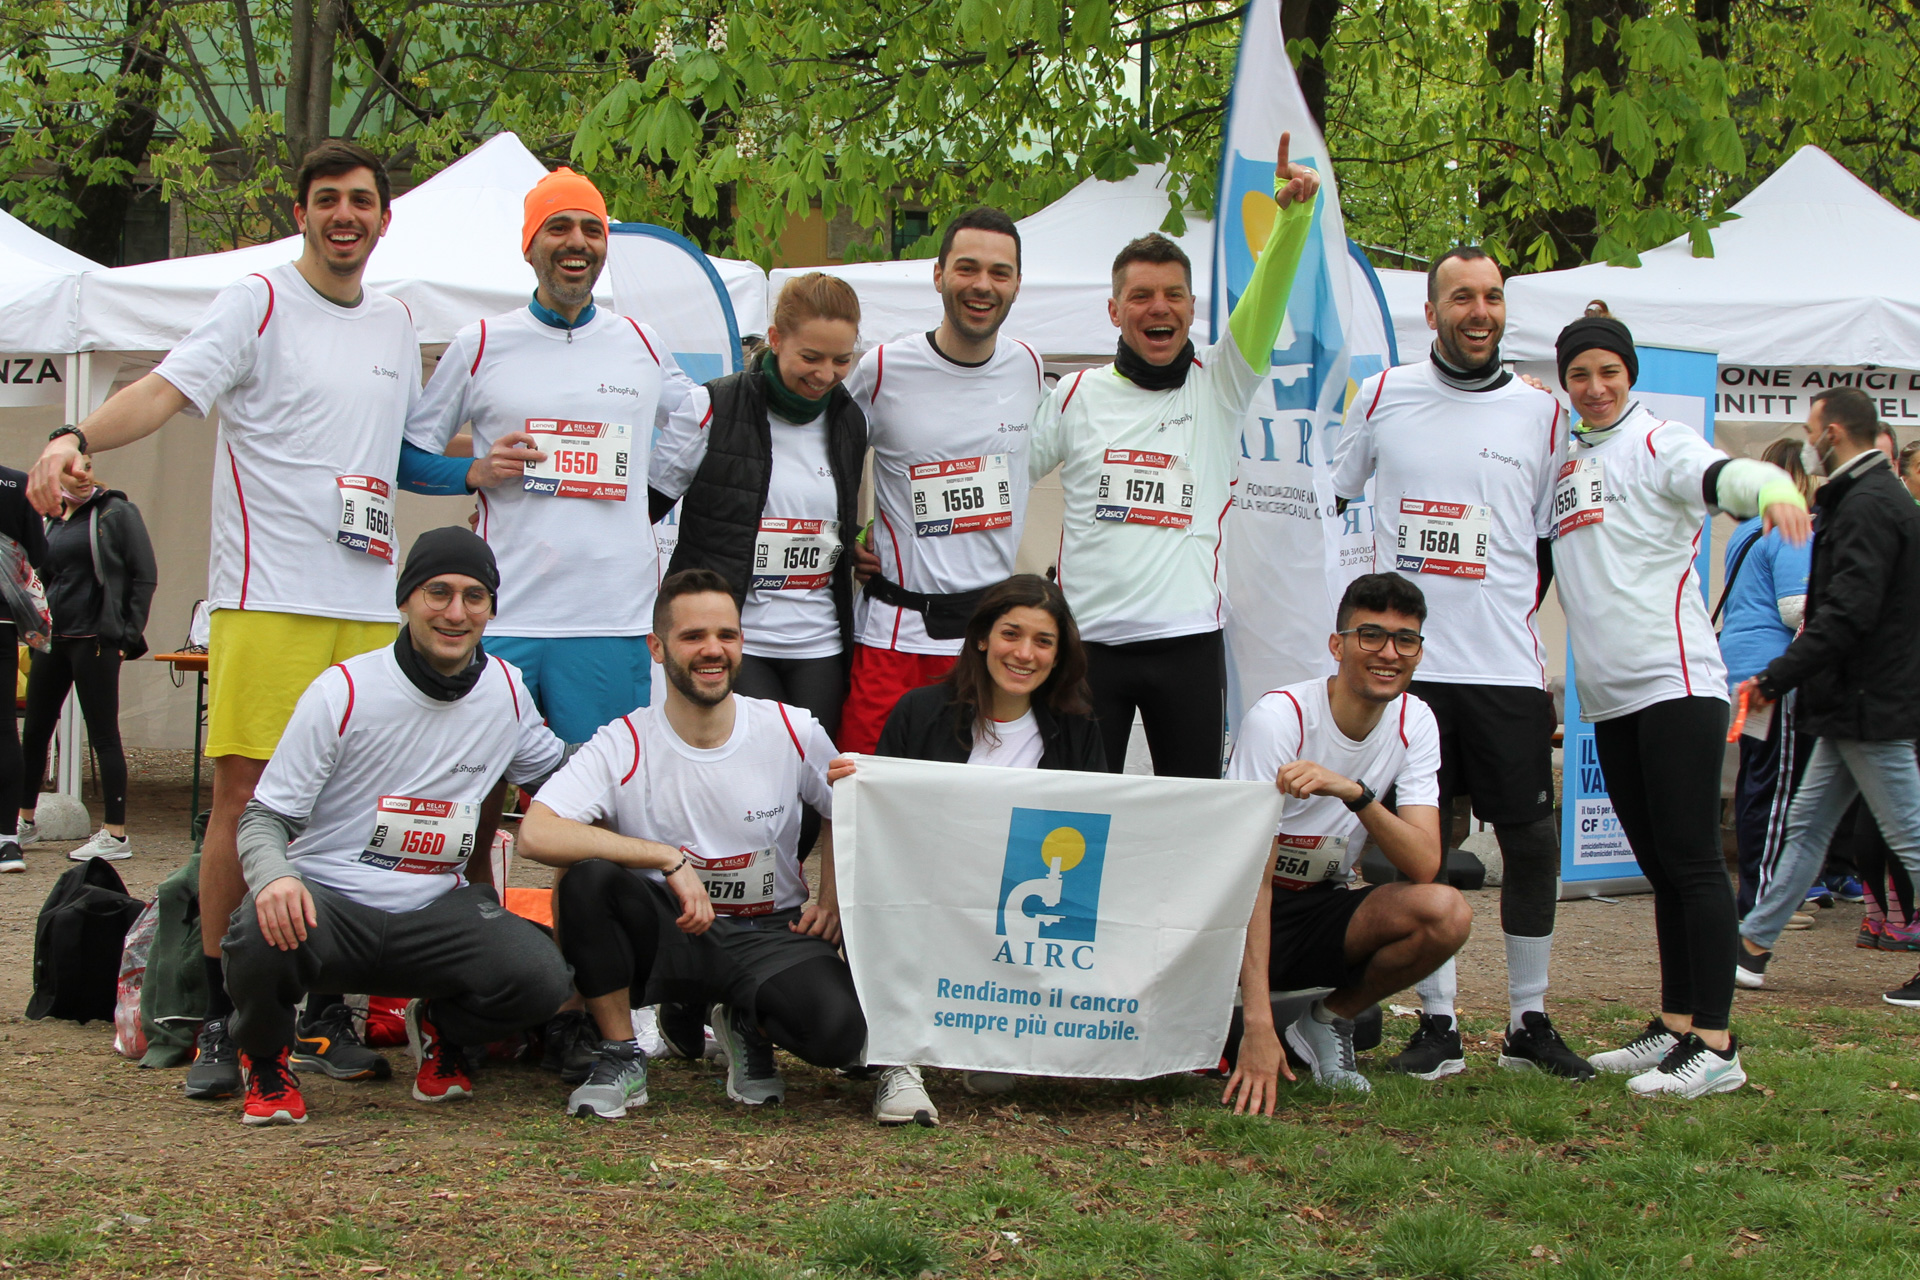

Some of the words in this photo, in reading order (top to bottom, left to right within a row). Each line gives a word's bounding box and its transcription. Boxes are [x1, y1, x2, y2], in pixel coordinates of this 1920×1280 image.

[1721, 368, 1792, 386] ONE
[1802, 372, 1897, 390] AMICI
[608, 386, 640, 398] ShopFully
[554, 450, 598, 475] 155D
[1490, 452, 1522, 469] ShopFully
[942, 486, 984, 512] 155B
[1126, 479, 1164, 504] 157A
[1555, 487, 1578, 516] 155C
[366, 507, 388, 535] 156B
[1241, 498, 1254, 510] LA
[1298, 507, 1311, 520] SUL
[1420, 529, 1460, 554] 158A
[784, 547, 820, 568] 154C
[1582, 739, 1596, 765] IL
[1587, 806, 1595, 814] tuo
[1597, 805, 1600, 814] 5
[1601, 806, 1611, 816] per
[1582, 819, 1598, 832] CF
[400, 830, 446, 855] 156D
[1275, 855, 1310, 876] 55A
[703, 881, 746, 899] 157B
[992, 940, 1094, 970] AIRC
[937, 978, 1041, 1006] Rendiamo
[1049, 988, 1063, 1008] il
[1070, 994, 1139, 1014] cancro
[934, 1011, 1008, 1034] sempre
[1014, 1014, 1047, 1038] più
[1054, 1020, 1139, 1040] curabile.
